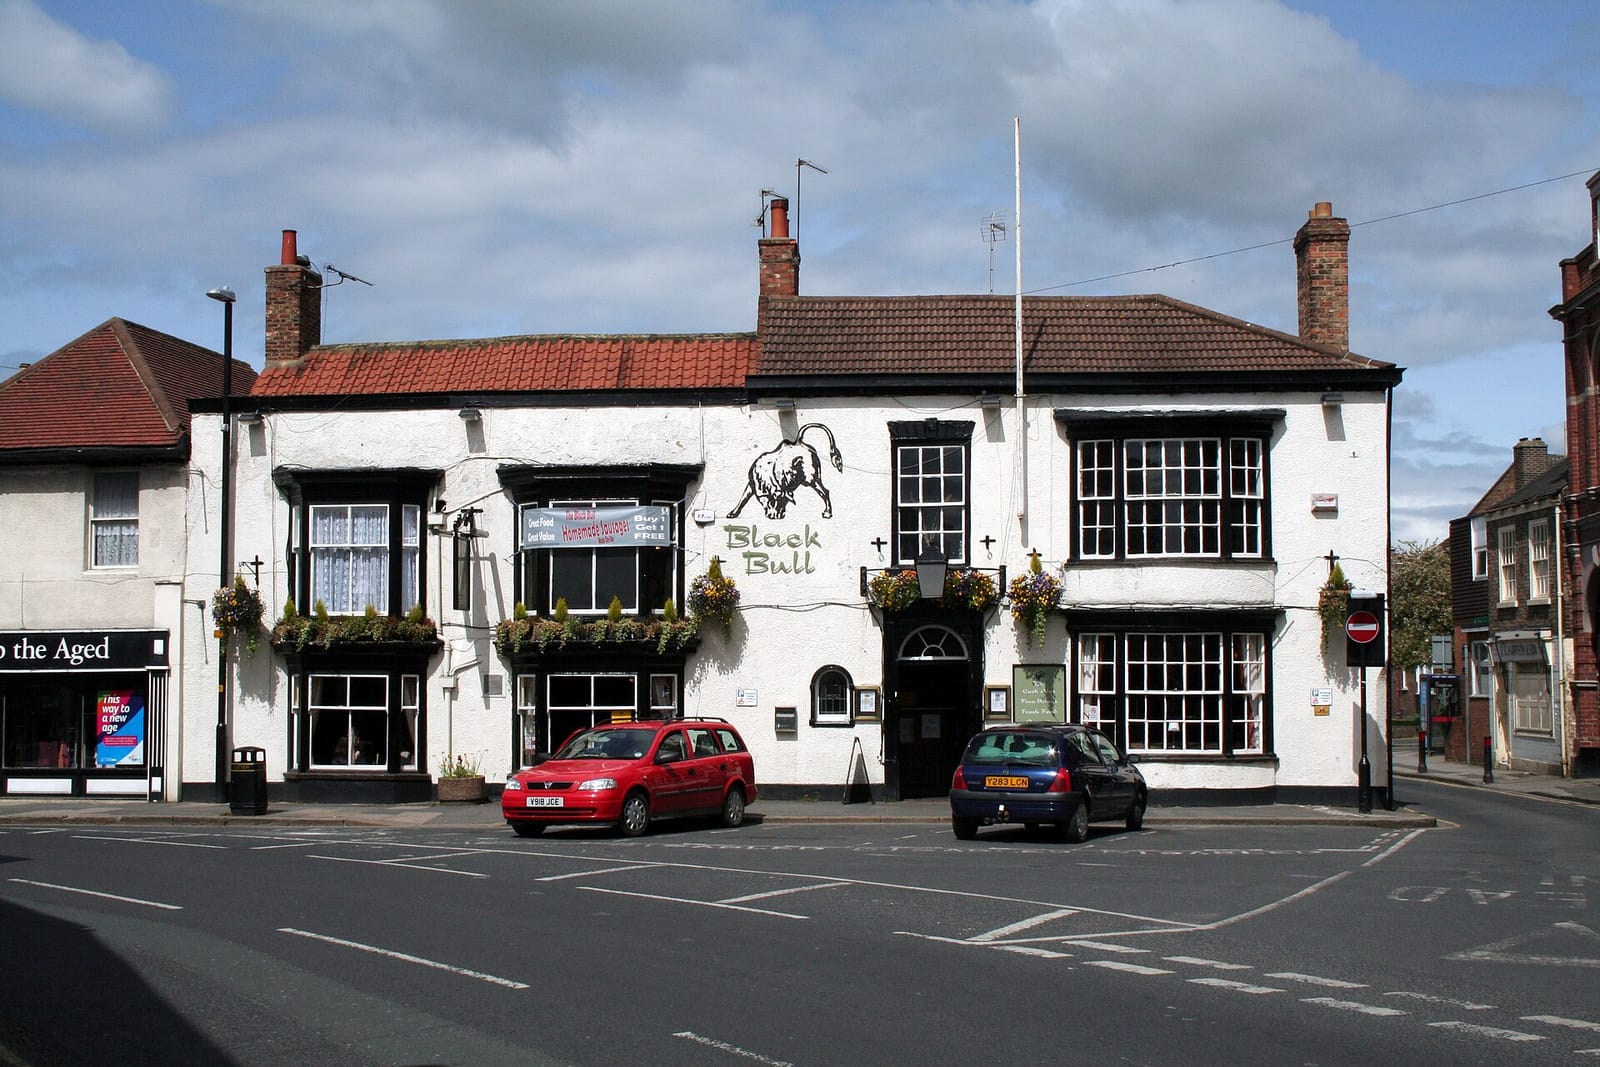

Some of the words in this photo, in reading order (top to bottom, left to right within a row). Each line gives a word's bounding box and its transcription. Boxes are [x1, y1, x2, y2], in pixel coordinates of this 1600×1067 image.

[540, 517, 554, 527] Food
[634, 515, 658, 523] Buy
[562, 521, 600, 541] Homemade
[600, 520, 630, 536] Sausages
[539, 531, 555, 541] Value
[634, 532, 665, 540] FREE
[723, 524, 822, 550] Black
[742, 550, 816, 576] Bull
[13, 637, 47, 659] the
[53, 636, 110, 666] Aged
[102, 705, 119, 716] way
[120, 704, 130, 713] to
[102, 715, 108, 723] a
[109, 714, 127, 723] new
[102, 724, 118, 735] age
[987, 778, 1008, 786] Y283
[1010, 778, 1027, 786] LCN
[530, 797, 545, 805] V918
